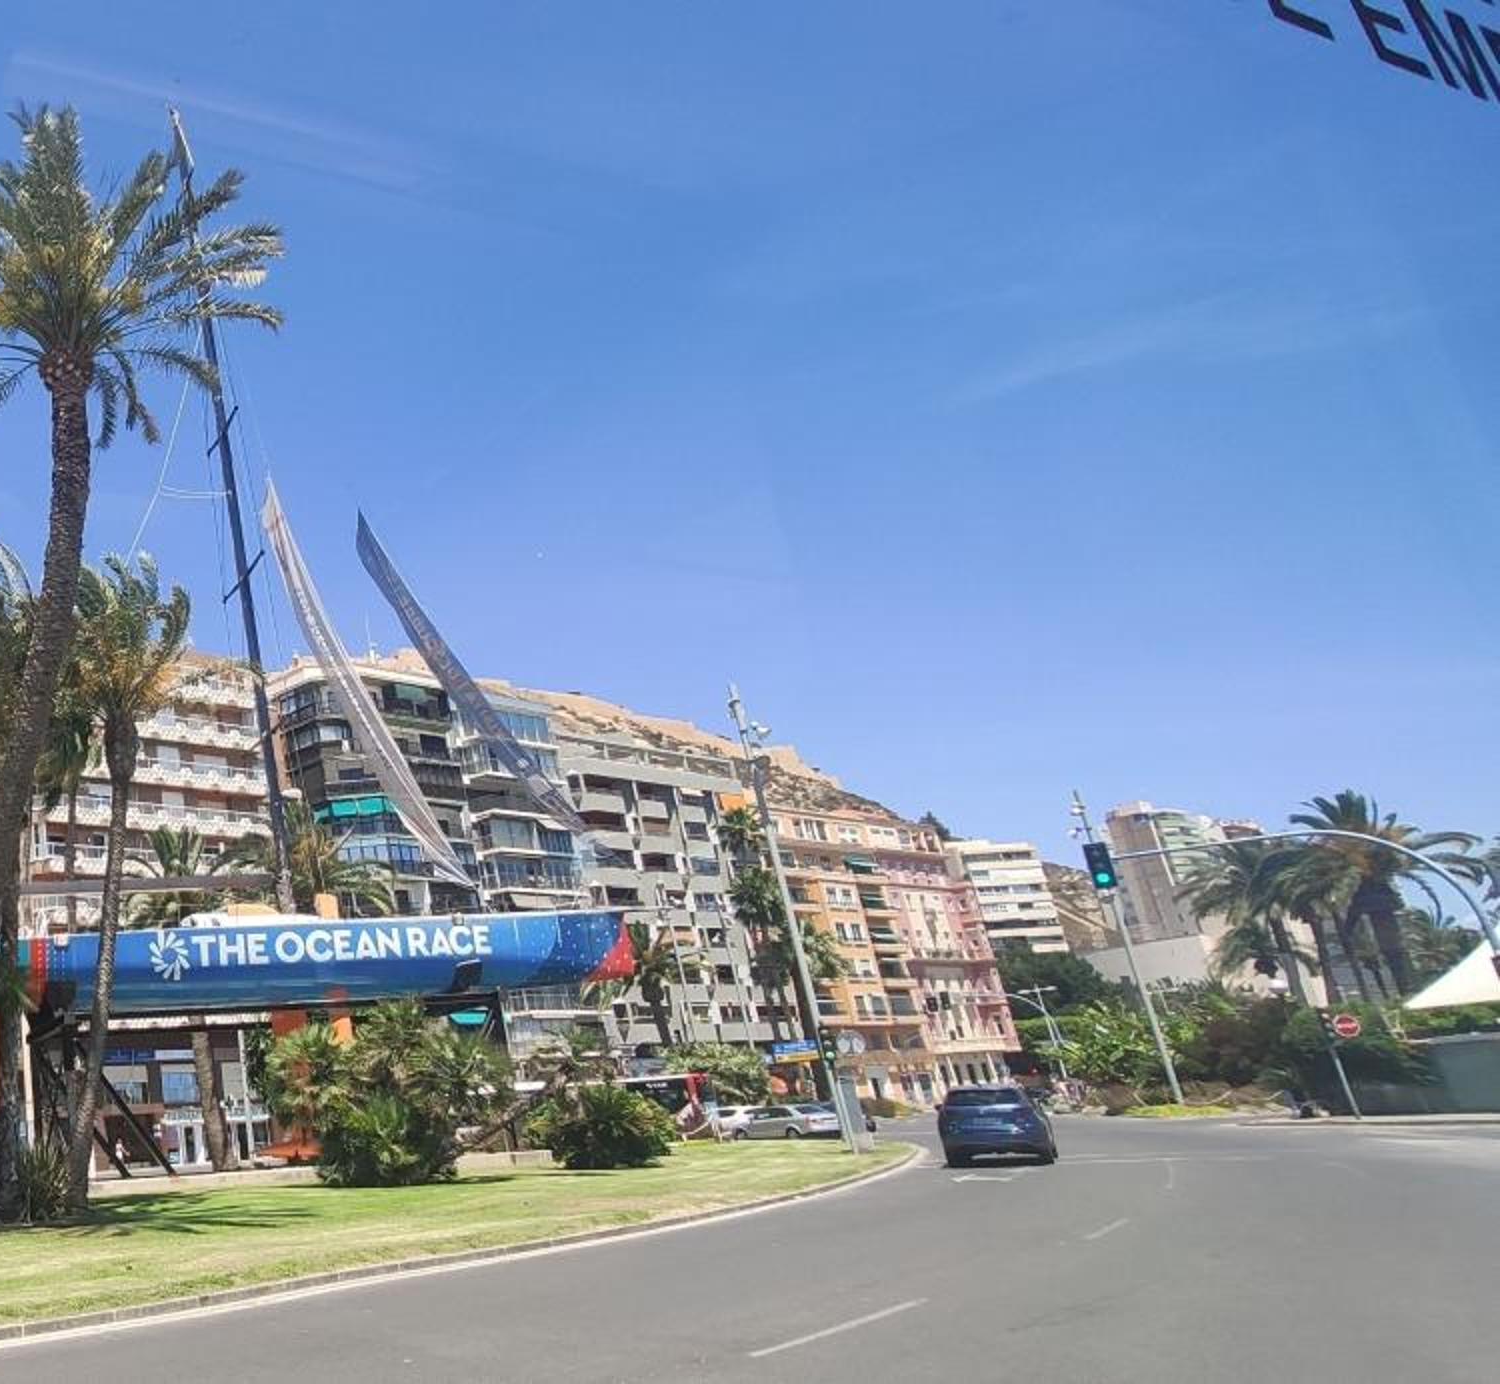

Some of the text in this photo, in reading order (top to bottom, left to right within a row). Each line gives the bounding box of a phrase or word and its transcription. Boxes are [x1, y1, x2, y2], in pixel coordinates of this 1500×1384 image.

[192, 925, 492, 967] THE OCEAN RACE
